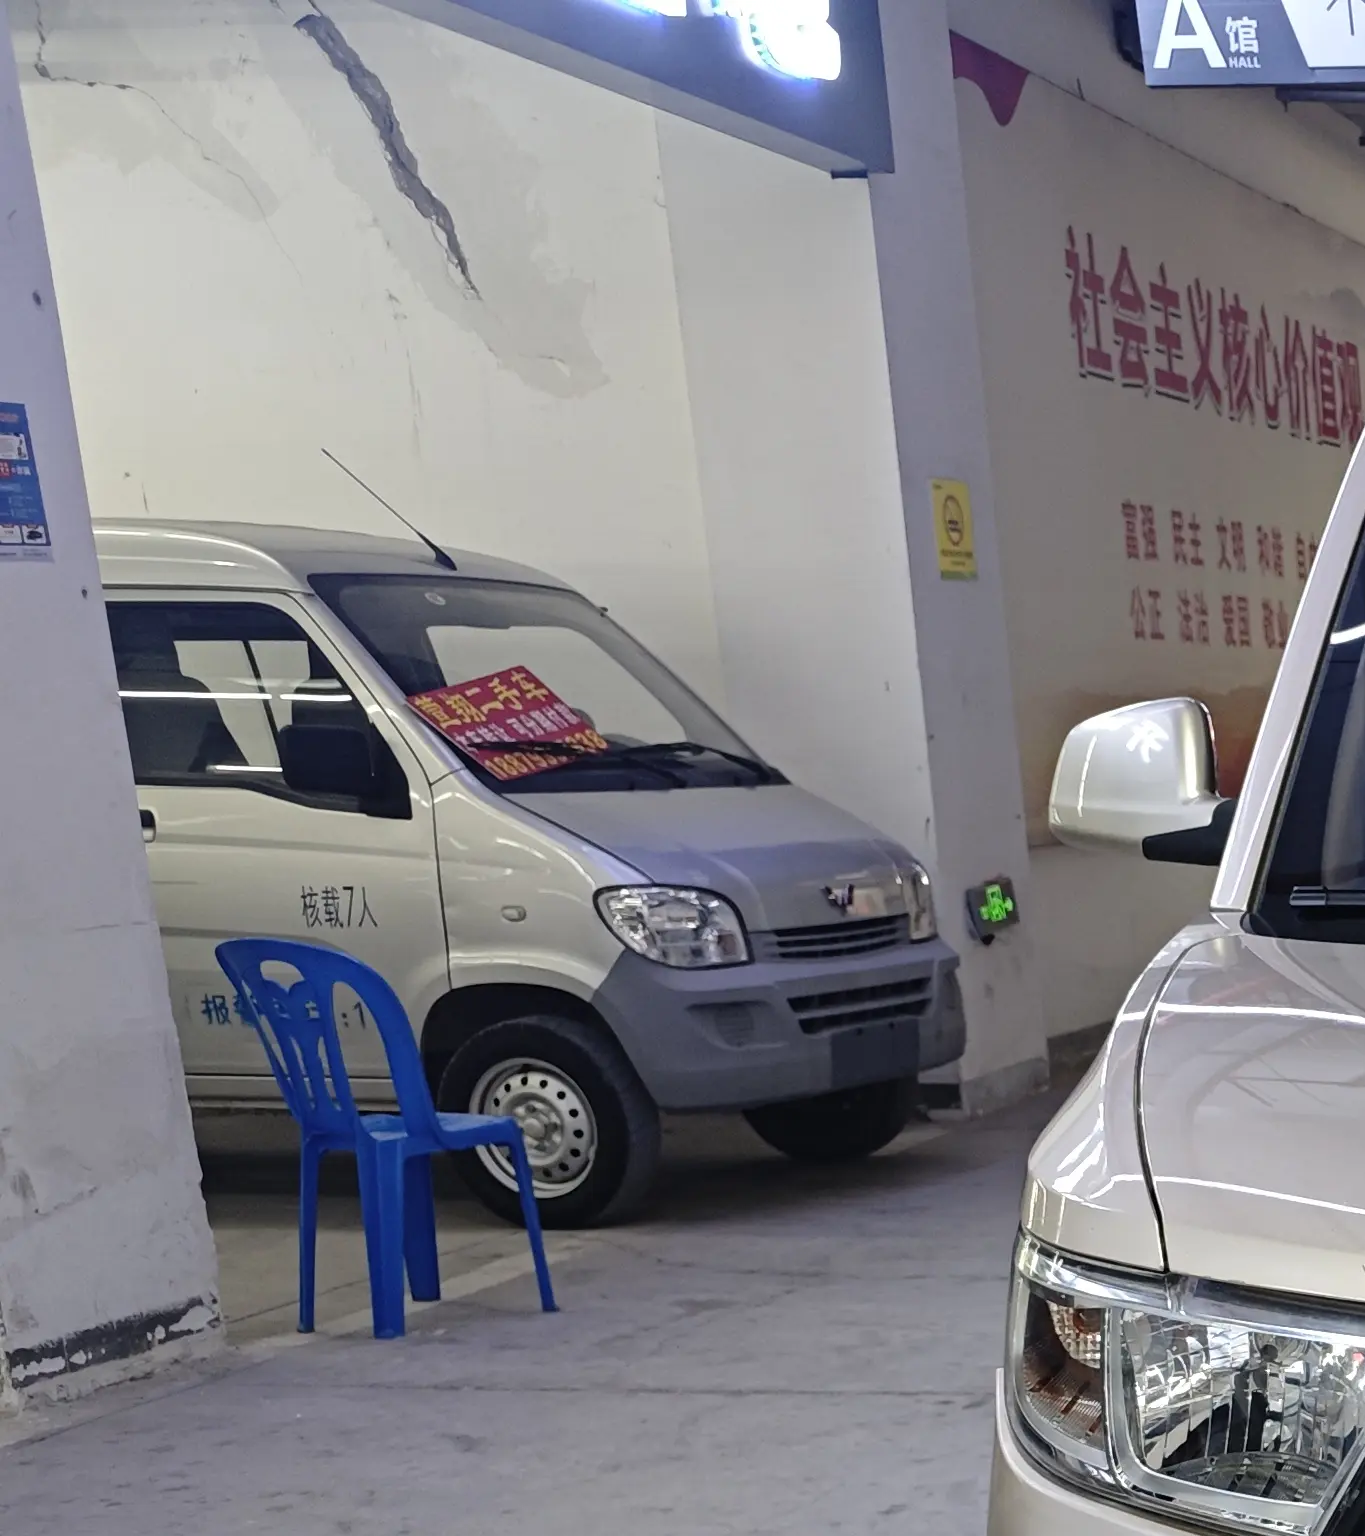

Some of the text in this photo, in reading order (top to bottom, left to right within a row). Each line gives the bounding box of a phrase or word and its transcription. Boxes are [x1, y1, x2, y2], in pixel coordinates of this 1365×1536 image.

[1227, 56, 1261, 69] HALL
[1064, 224, 1363, 446] 社会主义核心价值观
[1121, 498, 1160, 561] 富强
[1171, 510, 1205, 566] 民主
[1216, 515, 1248, 573] 文明
[1256, 524, 1284, 578] 和谐
[1130, 585, 1166, 640] 公正
[1177, 589, 1211, 646] 法治
[1221, 594, 1252, 648] 爱国
[300, 885, 379, 928] 核载7人
